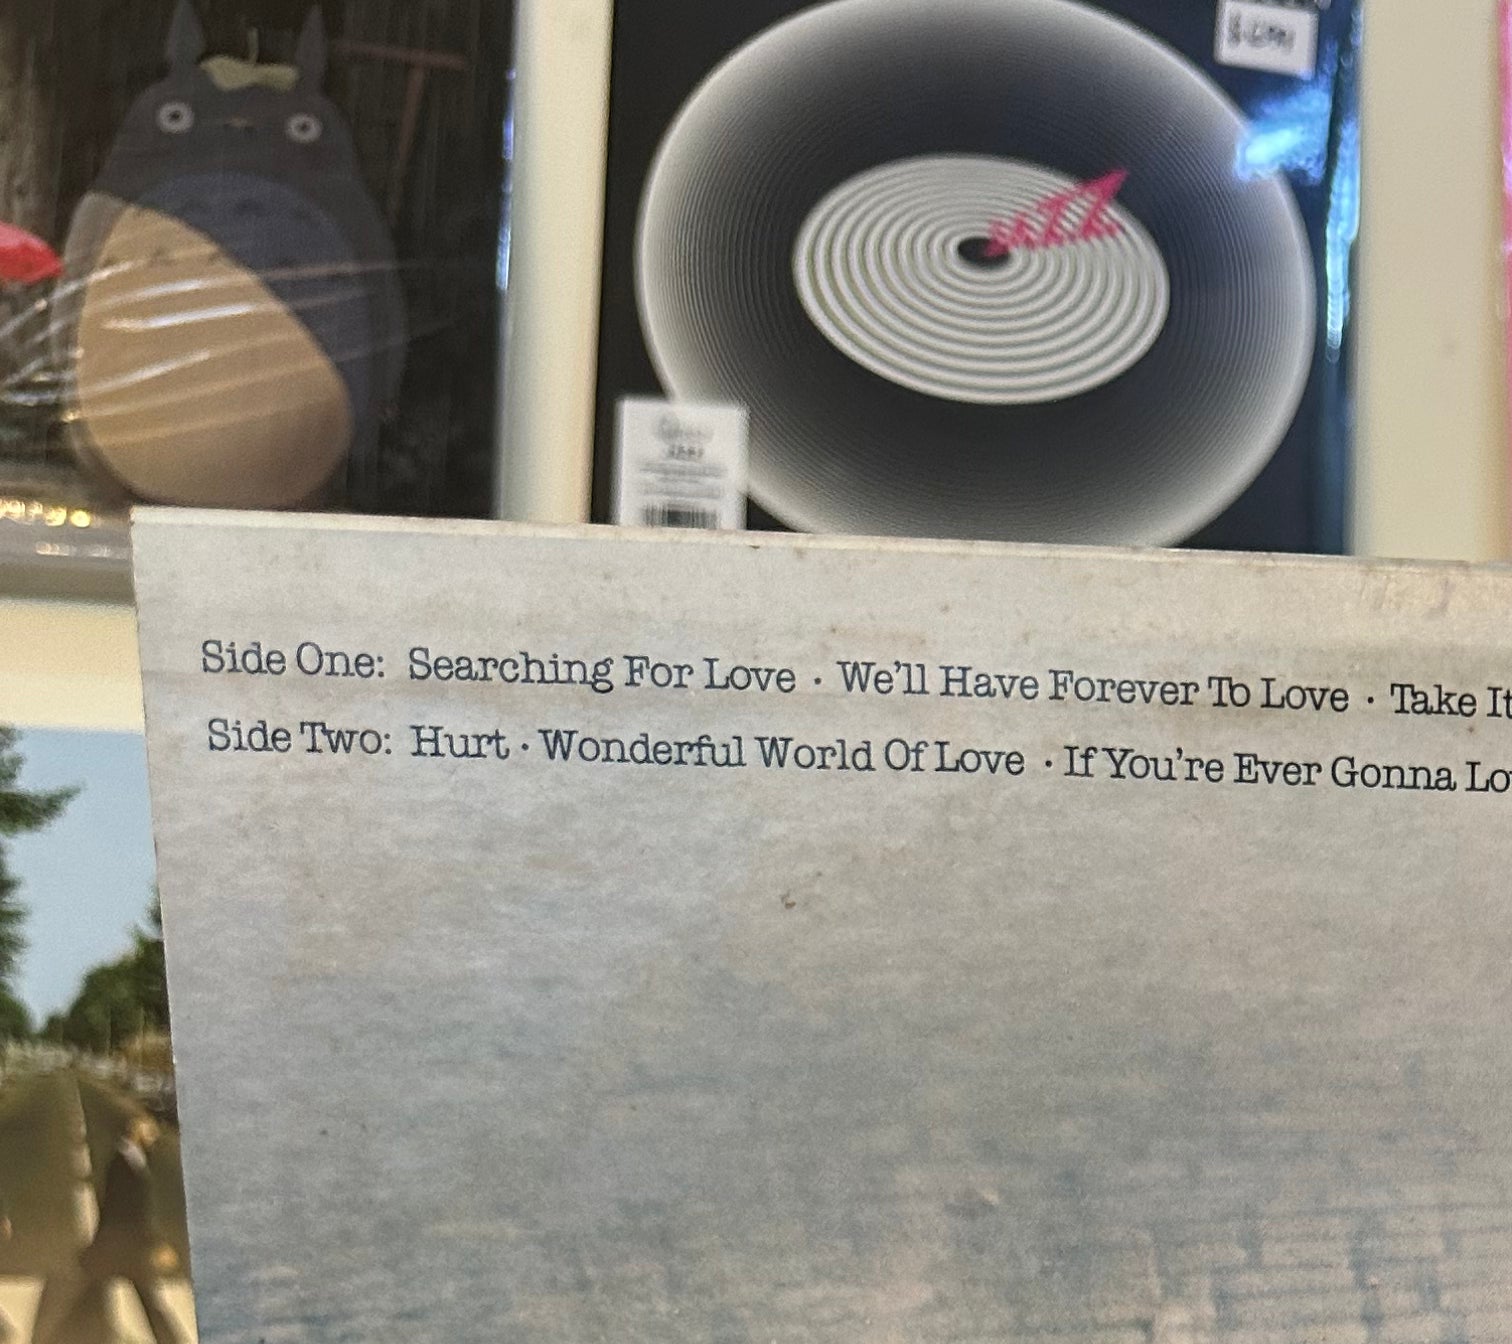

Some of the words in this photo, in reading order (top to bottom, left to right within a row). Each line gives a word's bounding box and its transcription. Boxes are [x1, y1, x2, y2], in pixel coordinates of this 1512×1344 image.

[202, 640, 286, 675] Side
[296, 642, 384, 678] One:
[409, 647, 614, 694] Searching
[623, 655, 694, 688] For
[703, 658, 795, 693] Love
[836, 661, 929, 694] We'll
[939, 666, 1038, 700] Have
[1049, 669, 1199, 705] Forever
[1208, 676, 1250, 707] To
[1260, 678, 1348, 712] Love
[1391, 683, 1476, 718] Take
[208, 718, 291, 752] Side
[300, 721, 391, 754] Two:
[410, 725, 510, 760] Hurt
[538, 729, 747, 767] Wonderful
[754, 737, 876, 771] World
[885, 738, 929, 771] Of
[934, 741, 1024, 775] Love
[1064, 745, 1098, 777] If
[1102, 747, 1224, 783] You're
[1233, 753, 1322, 786] Ever
[1331, 756, 1457, 791] Gonna
